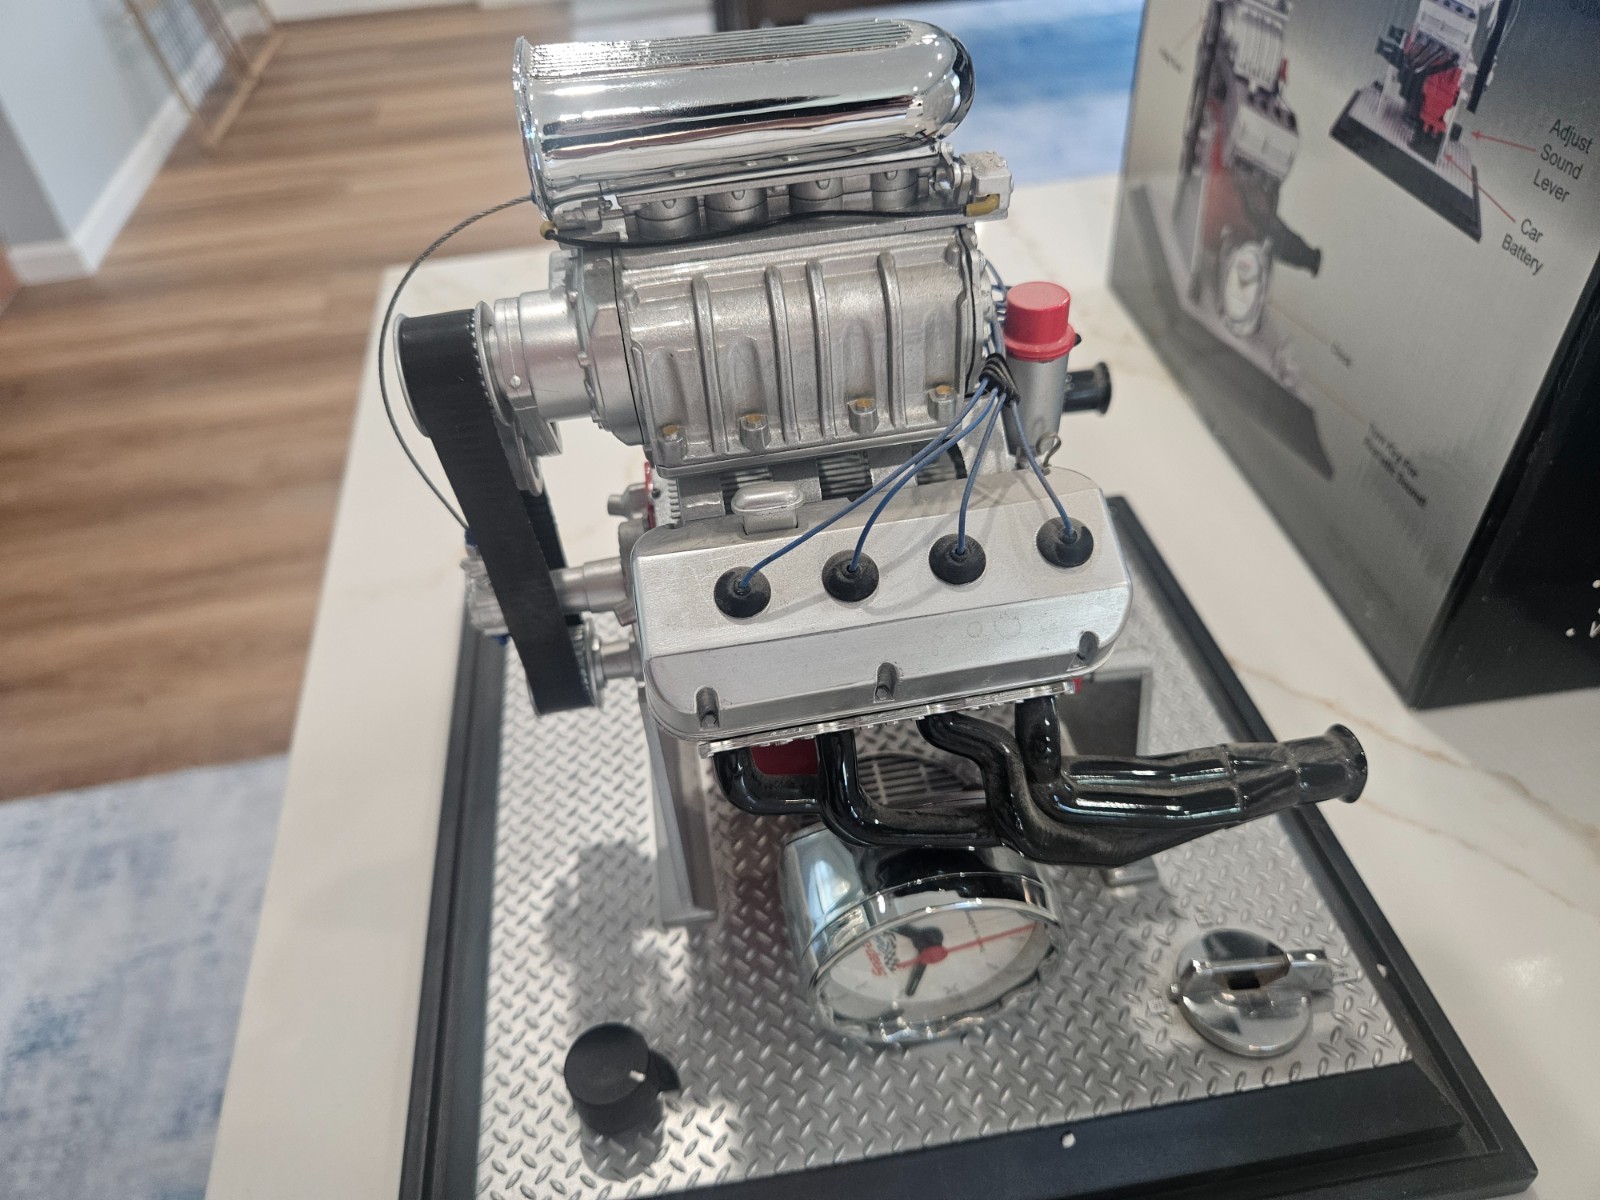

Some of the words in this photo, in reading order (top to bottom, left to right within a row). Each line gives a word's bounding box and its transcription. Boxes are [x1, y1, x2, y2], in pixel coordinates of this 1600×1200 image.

[1549, 119, 1593, 154] Adjust
[1540, 143, 1584, 180] Sound
[1533, 168, 1570, 203] Lever
[1520, 218, 1544, 243] Car
[1501, 233, 1544, 276] Battery
